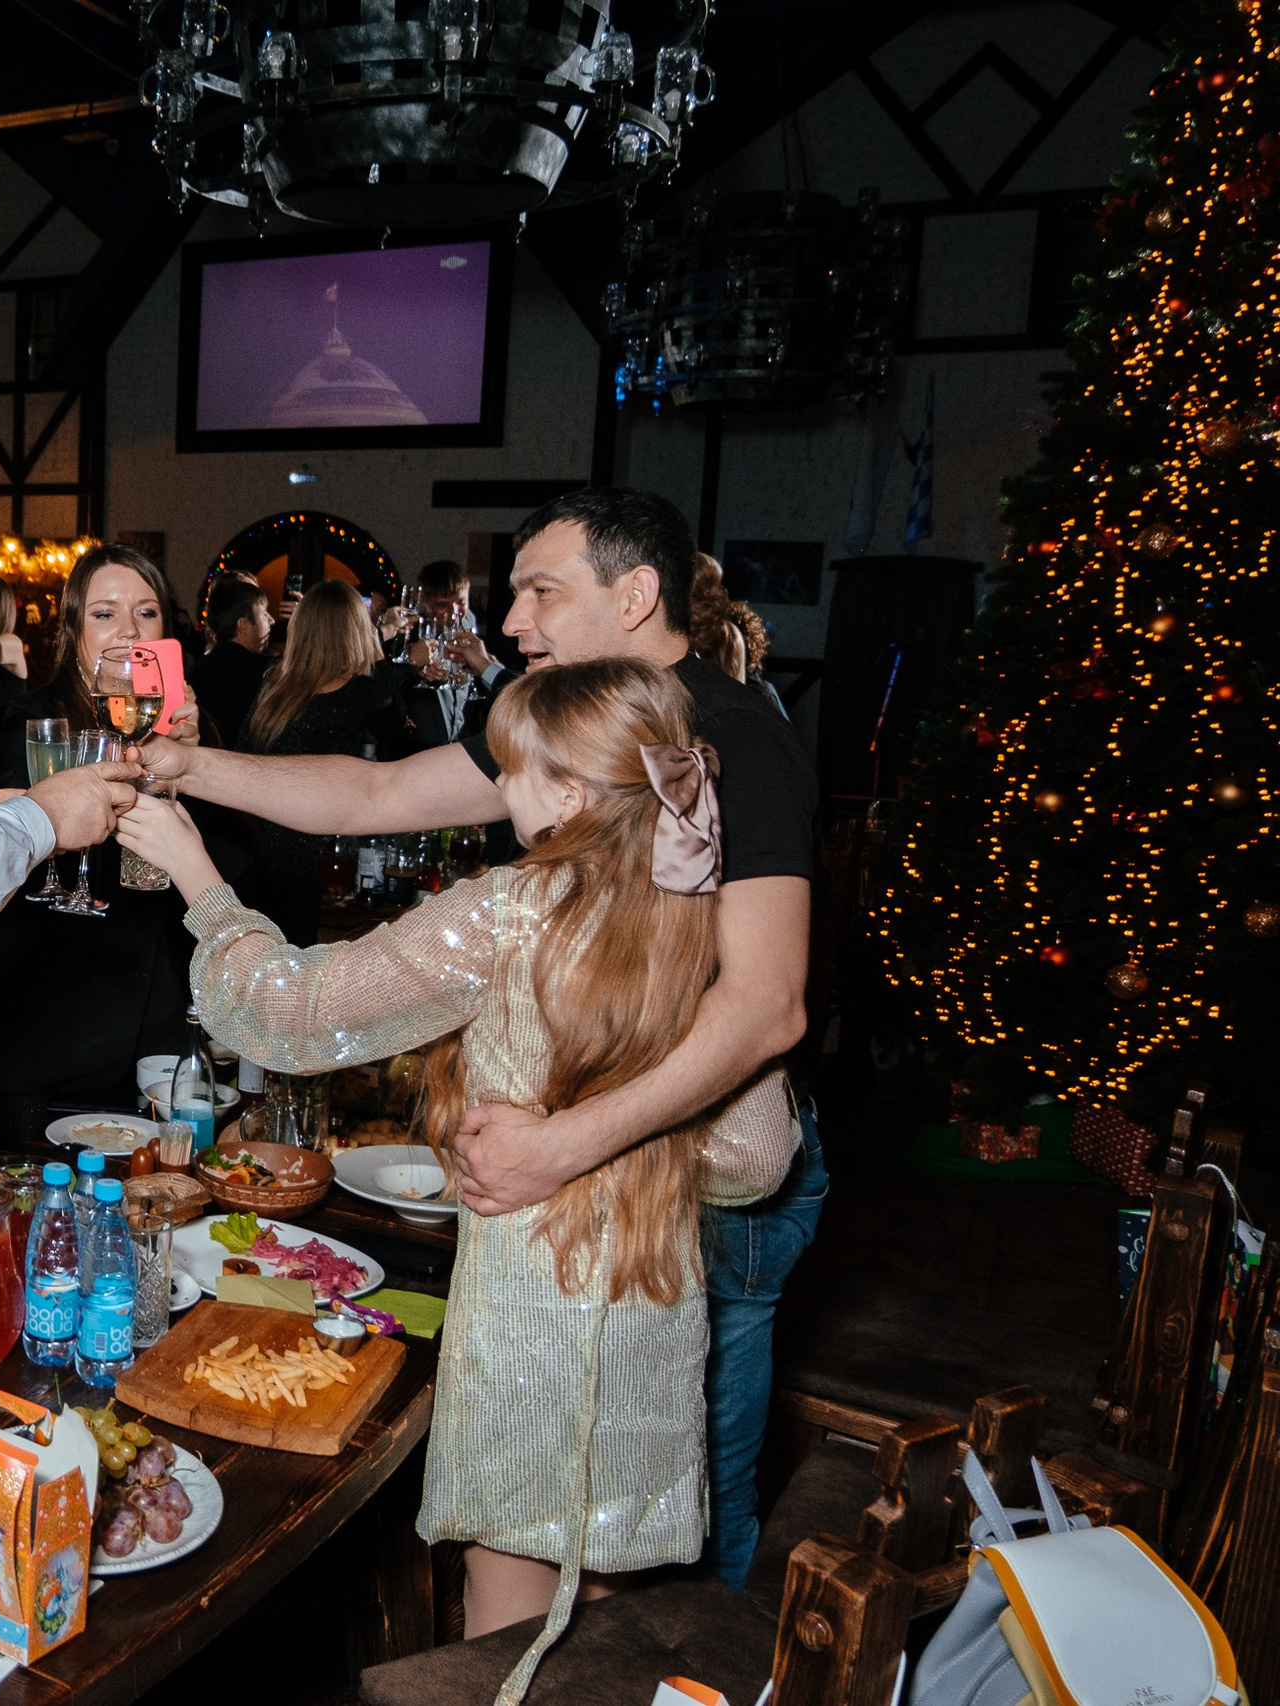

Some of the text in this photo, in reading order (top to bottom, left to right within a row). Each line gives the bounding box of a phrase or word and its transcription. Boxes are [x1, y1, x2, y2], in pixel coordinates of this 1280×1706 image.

[29, 1301, 73, 1321] bona
[28, 1318, 73, 1337] aqua
[110, 1326, 131, 1340] bo
[110, 1339, 131, 1354] aq
